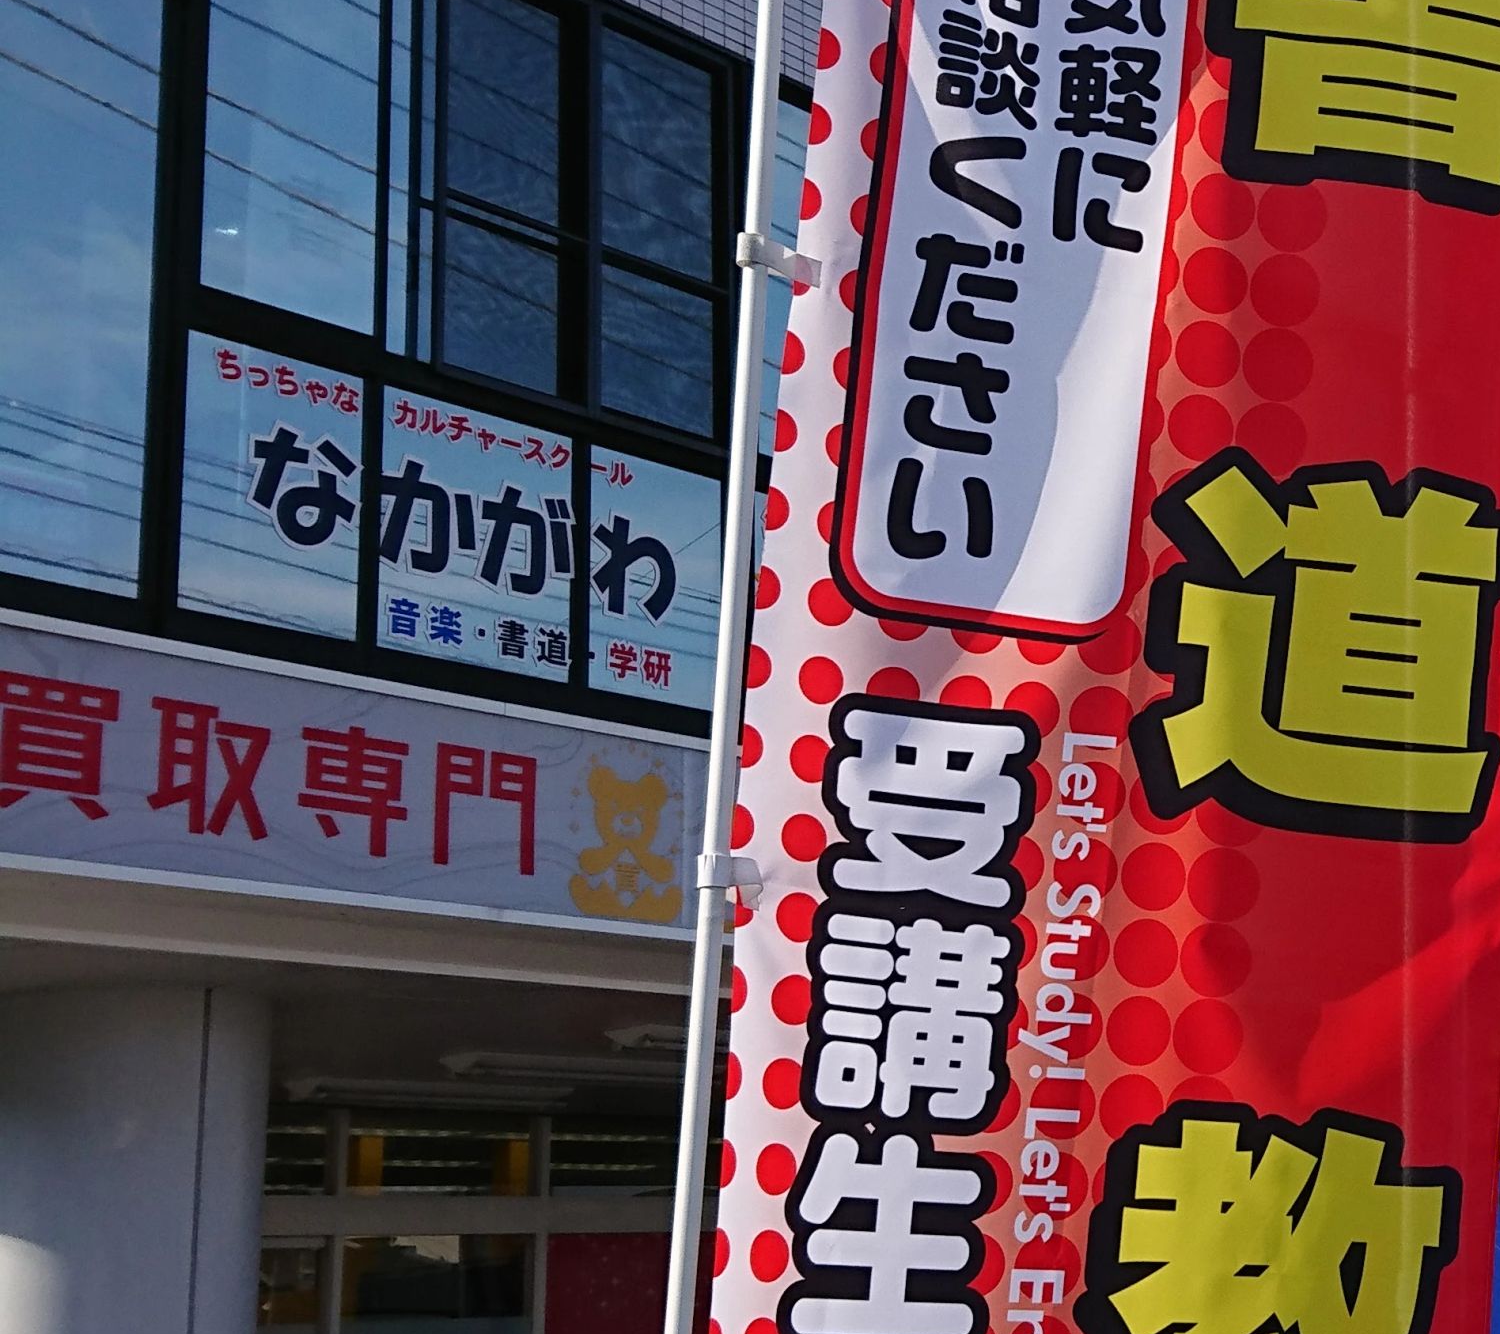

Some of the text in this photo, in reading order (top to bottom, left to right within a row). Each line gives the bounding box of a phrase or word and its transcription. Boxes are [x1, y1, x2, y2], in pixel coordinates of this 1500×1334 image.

[215, 349, 634, 487] ちっちゃな カルチャースクール
[248, 427, 678, 623] なかがわ
[0, 673, 538, 877] 買取専門
[1051, 732, 1118, 862] Let's
[1018, 882, 1102, 1085] Study!
[1013, 1105, 1084, 1245] Let's
